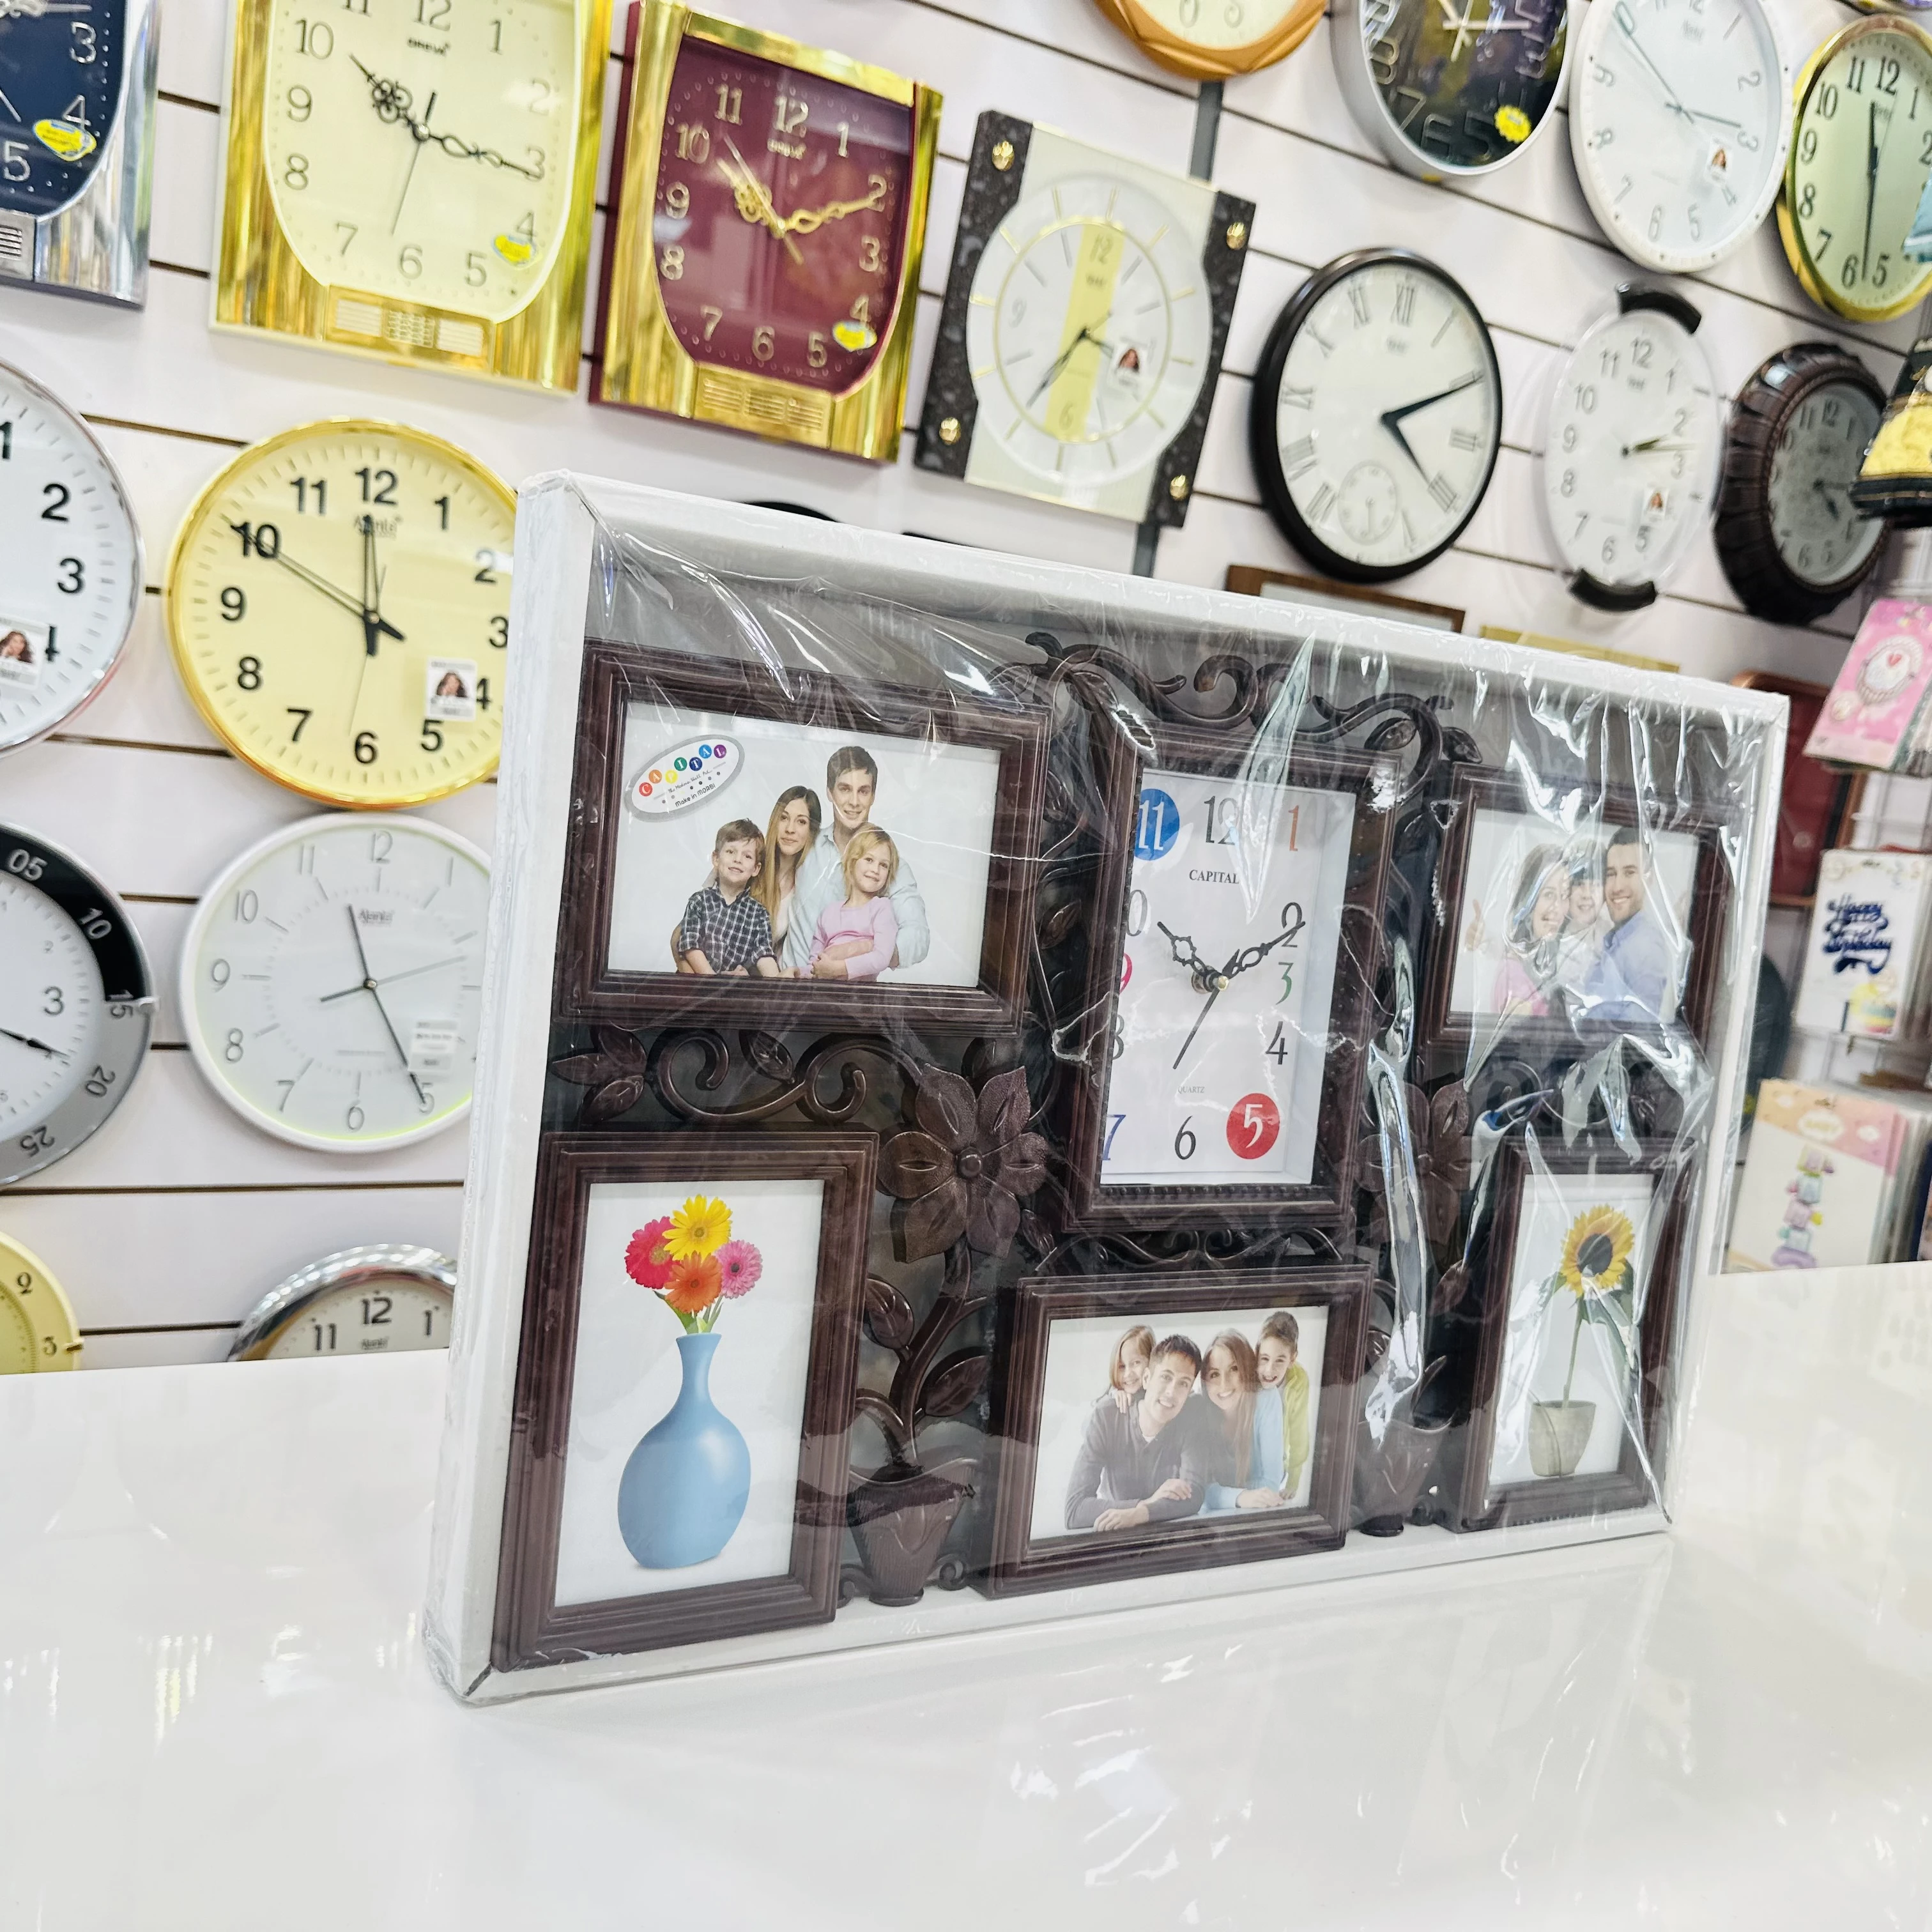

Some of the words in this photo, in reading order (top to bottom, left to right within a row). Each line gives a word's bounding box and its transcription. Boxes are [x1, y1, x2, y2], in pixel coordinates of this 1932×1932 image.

[413, 0, 450, 31] 12
[1723, 14, 1742, 40] 1
[71, 22, 96, 63] 3
[295, 18, 334, 59] 10
[489, 20, 503, 55] 1
[1593, 64, 1614, 88] 9
[1737, 71, 1761, 96] 2
[1846, 57, 1866, 94] 11
[1876, 57, 1899, 96] 12
[64, 95, 91, 130] 4
[286, 84, 311, 122] 9
[529, 77, 551, 116] 2
[716, 84, 742, 125] 11
[1397, 86, 1426, 132] 7
[1815, 83, 1838, 120] 10
[1908, 88, 1920, 120] 1
[774, 95, 809, 136] 12
[675, 124, 710, 164] 10
[838, 123, 848, 158] 1
[1592, 128, 1614, 150] 8
[1737, 131, 1758, 151] 3
[1802, 131, 1818, 164] 9
[1920, 131, 1932, 166] 2
[3, 141, 31, 181] 5
[285, 153, 309, 190] 8
[526, 144, 546, 181] 3
[666, 182, 690, 219] 9
[868, 174, 887, 211] 2
[1614, 174, 1633, 205] 7
[1800, 184, 1816, 218] 8
[335, 221, 358, 256] 7
[516, 210, 538, 242] 4
[1648, 205, 1662, 242] 6
[1687, 204, 1701, 241] 5
[399, 244, 423, 279] 6
[660, 244, 685, 281] 8
[859, 236, 881, 272] 3
[1090, 233, 1113, 264] 12
[1816, 230, 1832, 262] 7
[465, 250, 487, 287] 5
[1842, 256, 1857, 288] 6
[1872, 256, 1889, 288] 5
[850, 295, 870, 325] 4
[1009, 298, 1027, 328] 9
[1348, 284, 1369, 330] XI
[1392, 282, 1416, 326] XII
[703, 305, 723, 342] 7
[753, 326, 775, 361] 6
[807, 331, 828, 368] 5
[1307, 328, 1334, 358] X
[1631, 339, 1652, 368] 12
[1600, 350, 1620, 379] 11
[1667, 368, 1676, 394] 1
[1282, 385, 1314, 410] IX
[1575, 384, 1596, 415] 10
[1059, 402, 1075, 431] 6
[1672, 409, 1688, 437] 2
[0, 421, 12, 459] 1
[1563, 425, 1576, 453] 9
[1671, 452, 1685, 479] 3
[290, 477, 327, 514] 11
[356, 467, 399, 506] 12
[1561, 470, 1575, 496] 8
[42, 483, 71, 521] 2
[435, 496, 450, 530] 1
[233, 524, 280, 559] 10
[1574, 512, 1589, 539] 7
[1636, 525, 1651, 553] 5
[474, 549, 497, 583] 2
[1602, 535, 1616, 564] 6
[57, 558, 84, 594] 3
[221, 587, 247, 622] 9
[489, 617, 508, 648] 3
[237, 656, 263, 691] 8
[476, 678, 491, 710] 4
[287, 709, 312, 742] 7
[421, 719, 443, 751] 5
[355, 732, 377, 764] 6
[639, 744, 727, 797] CAPITAL
[1137, 799, 1165, 851] 11
[1204, 794, 1238, 845] 12
[1288, 805, 1300, 852] 1
[7, 848, 48, 881] 05
[299, 845, 314, 875] 11
[371, 831, 393, 864] 12
[447, 857, 454, 887] 1
[1189, 869, 1239, 884] CAPITAL
[79, 907, 112, 940] 10
[234, 890, 259, 924] 10
[1281, 902, 1301, 947] 2
[211, 958, 231, 992] 9
[1276, 962, 1292, 1005] 3
[43, 986, 65, 1017] 3
[106, 989, 134, 1020] 15
[226, 1028, 243, 1062] 8
[1266, 1022, 1287, 1065] 4
[84, 1065, 116, 1098] 20
[277, 1078, 296, 1112] 7
[417, 1082, 435, 1114] 5
[20, 1125, 56, 1158] 25
[1102, 1114, 1126, 1160] 7
[1174, 1116, 1196, 1160] 6
[1243, 1104, 1263, 1148] 5
[17, 1271, 32, 1295] 2
[362, 1297, 392, 1326] 12
[424, 1310, 433, 1338] 1
[42, 1336, 57, 1358] 3
[313, 1322, 337, 1353] 11
